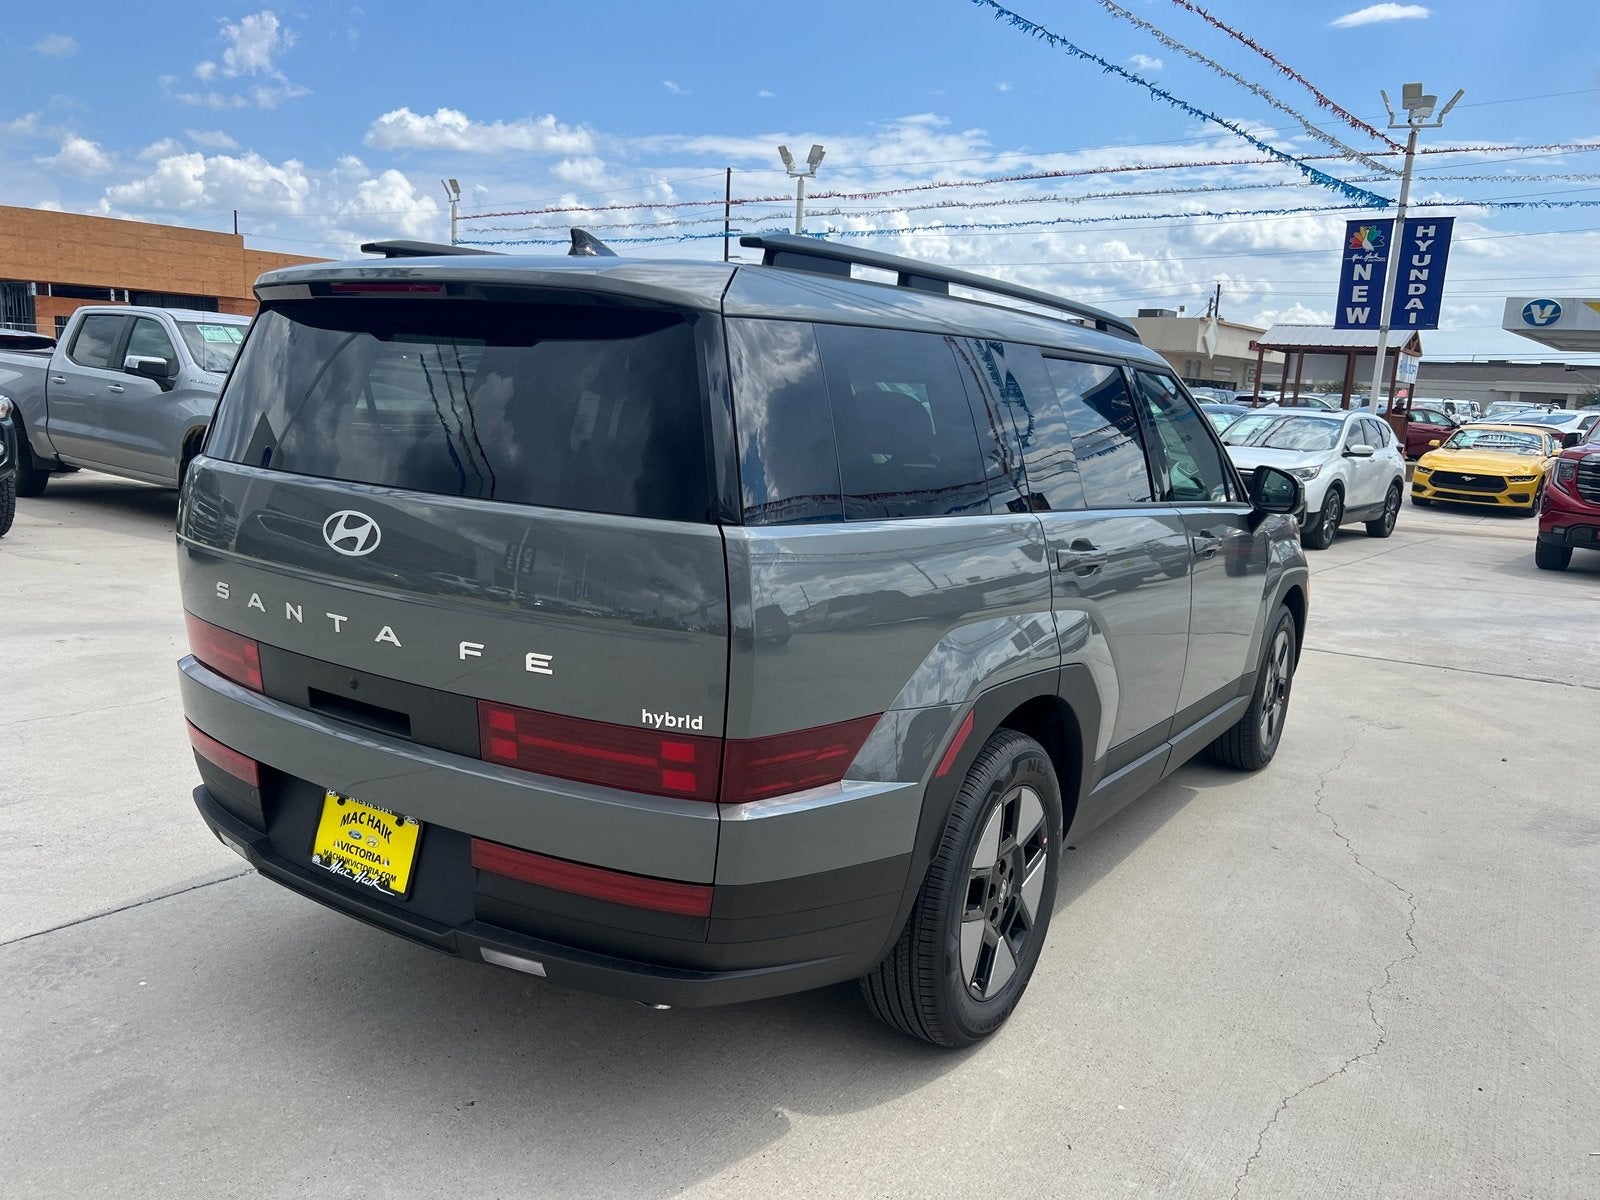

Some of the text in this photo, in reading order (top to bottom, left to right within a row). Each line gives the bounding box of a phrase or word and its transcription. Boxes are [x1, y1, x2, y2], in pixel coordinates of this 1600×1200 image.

[1346, 263, 1373, 324] NEW
[1404, 225, 1436, 324] HYUNDAI
[215, 580, 554, 675] SANTA FE
[641, 708, 703, 730] hybrid
[340, 811, 393, 844] MAC HAIK
[340, 840, 382, 865] VICTORIA
